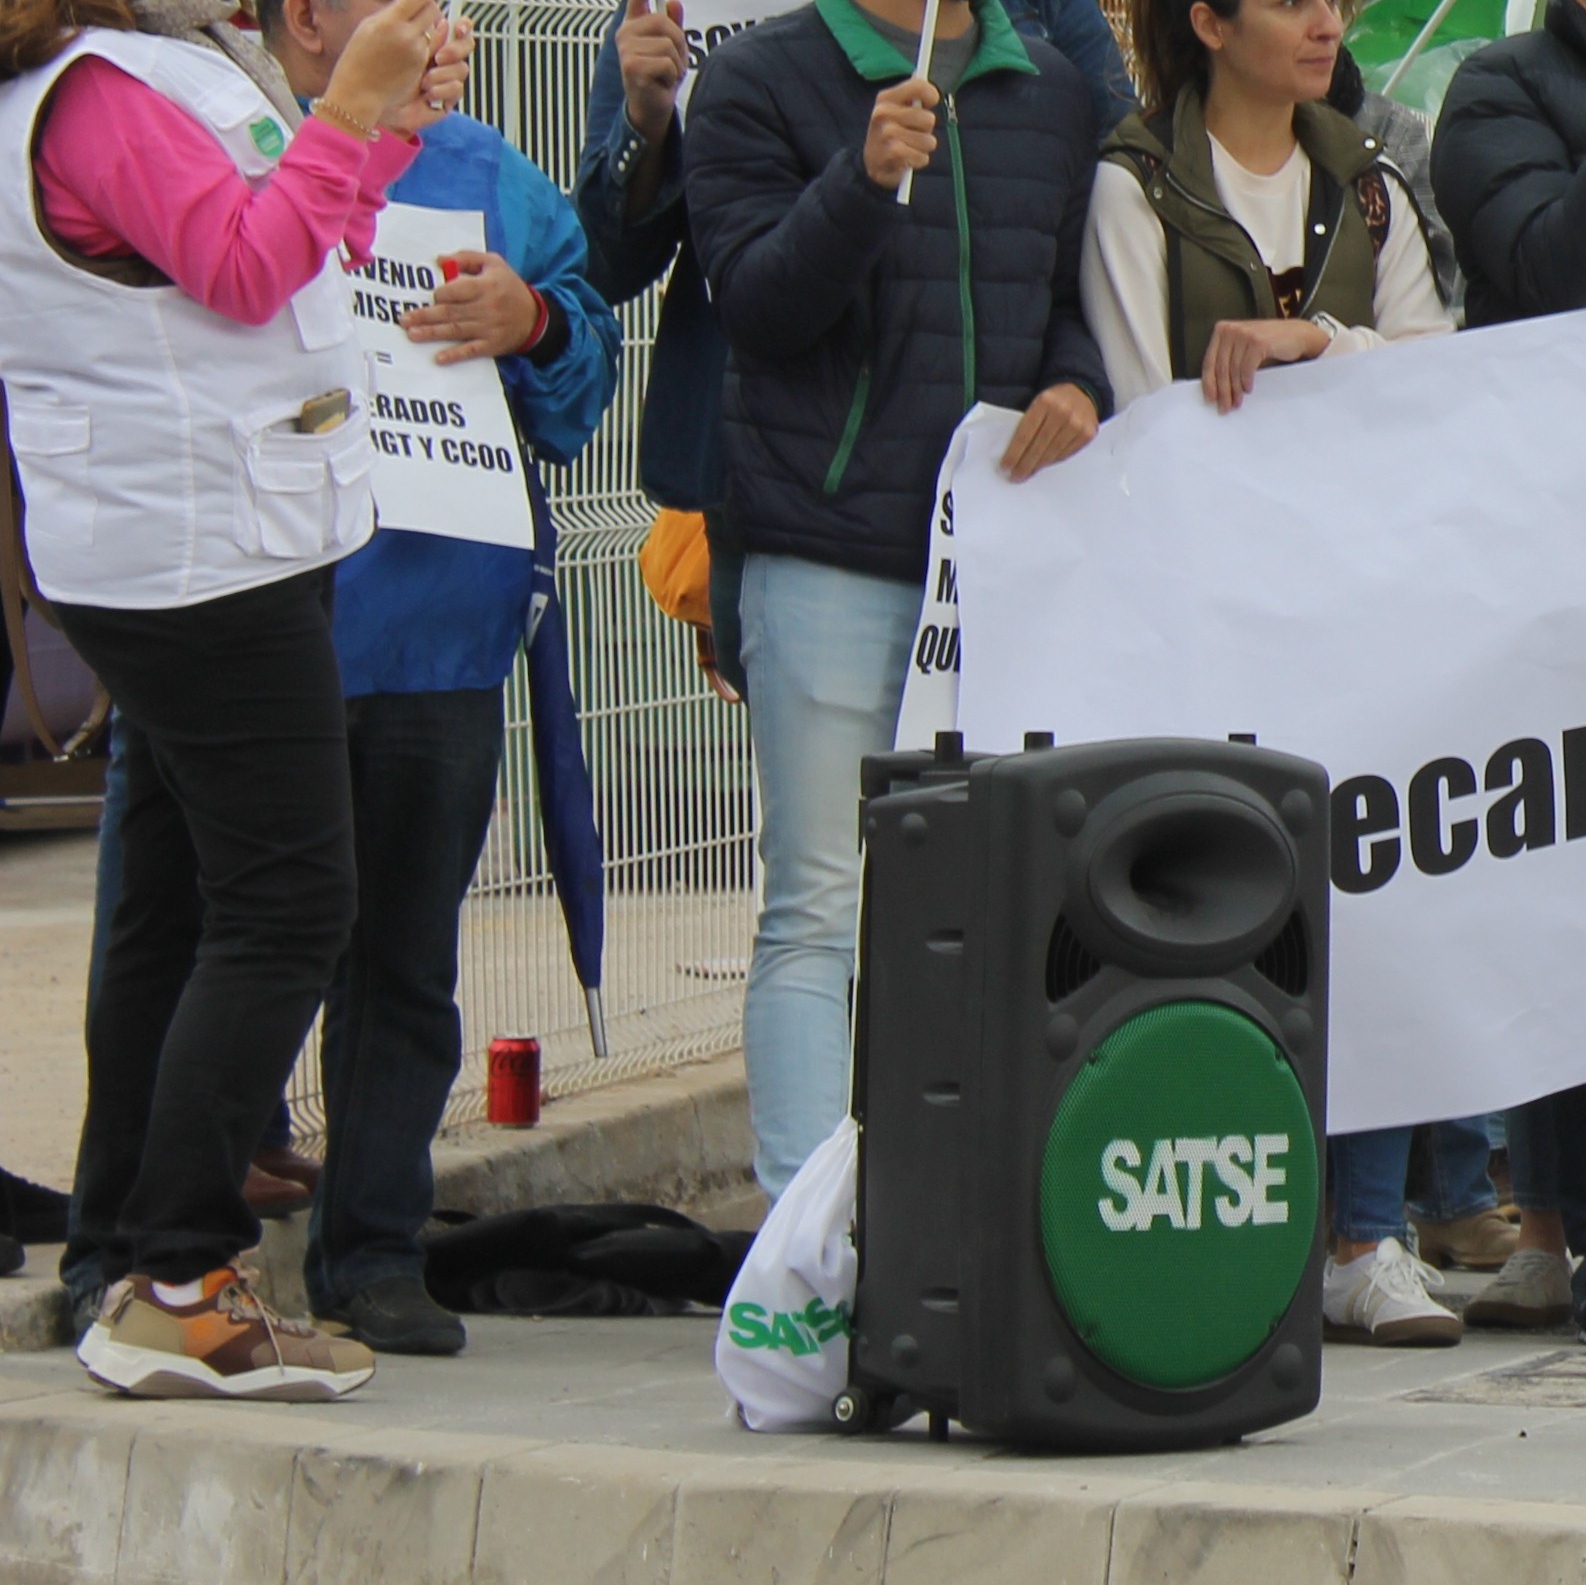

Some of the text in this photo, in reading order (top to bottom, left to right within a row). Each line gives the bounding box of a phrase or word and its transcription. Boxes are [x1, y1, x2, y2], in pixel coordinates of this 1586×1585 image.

[371, 393, 466, 428] RADOS
[417, 437, 434, 460] Y
[440, 437, 514, 473] CCOO
[1098, 1132, 1289, 1233] SATSE
